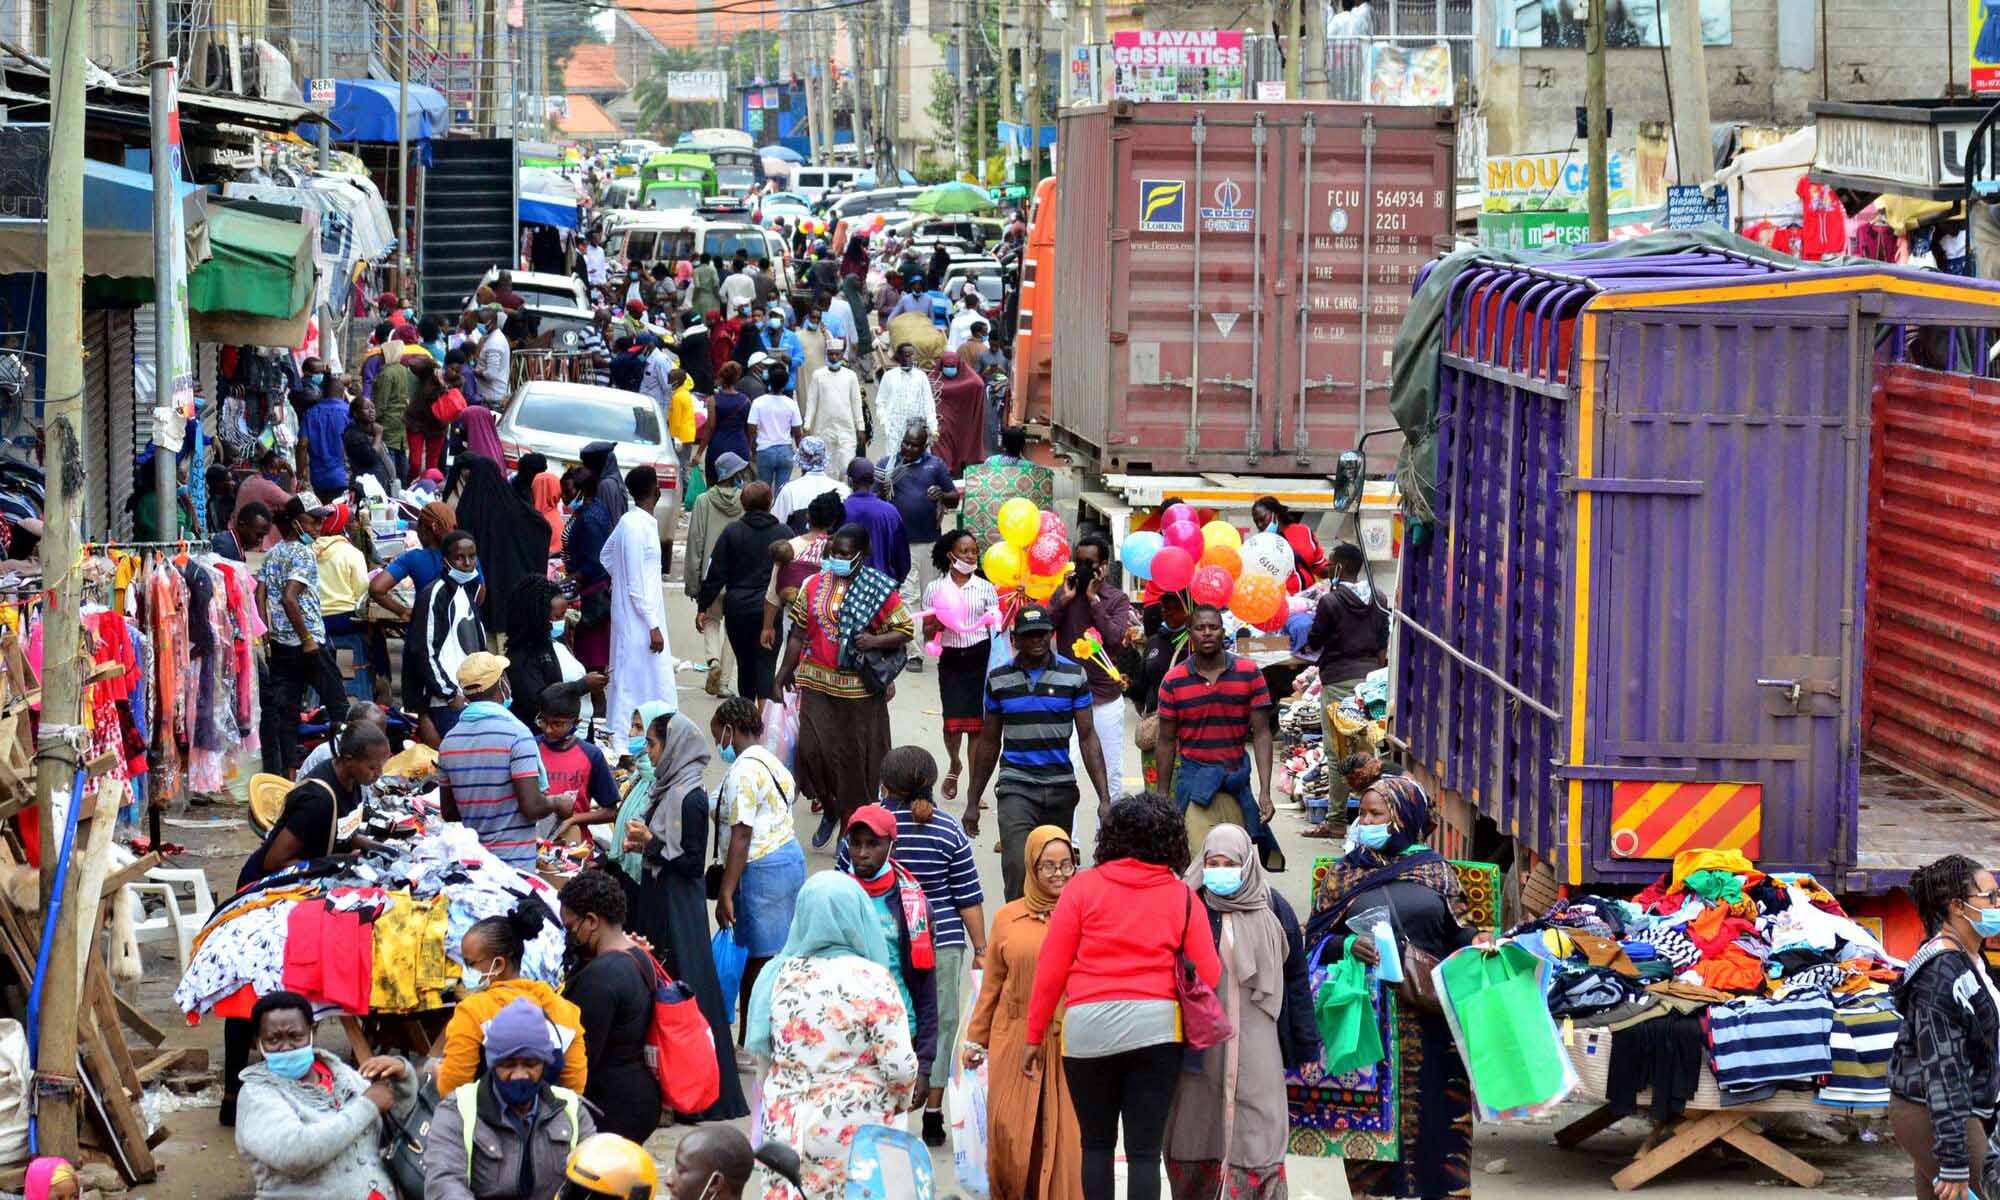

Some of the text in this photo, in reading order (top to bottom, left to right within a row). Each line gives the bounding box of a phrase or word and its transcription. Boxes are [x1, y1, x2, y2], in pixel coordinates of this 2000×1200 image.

[1140, 31, 1217, 46] RAYAN
[1115, 47, 1241, 64] COSMETICS
[1487, 158, 1560, 190] MOU
[1328, 190, 1359, 207] FCIU
[1376, 190, 1424, 207] 564934
[1141, 222, 1183, 230] FLORENS
[1376, 214, 1406, 230] 22G1
[1335, 236, 1358, 249] GROSS
[1315, 266, 1333, 280] TARE
[1334, 296, 1358, 310] CARGO
